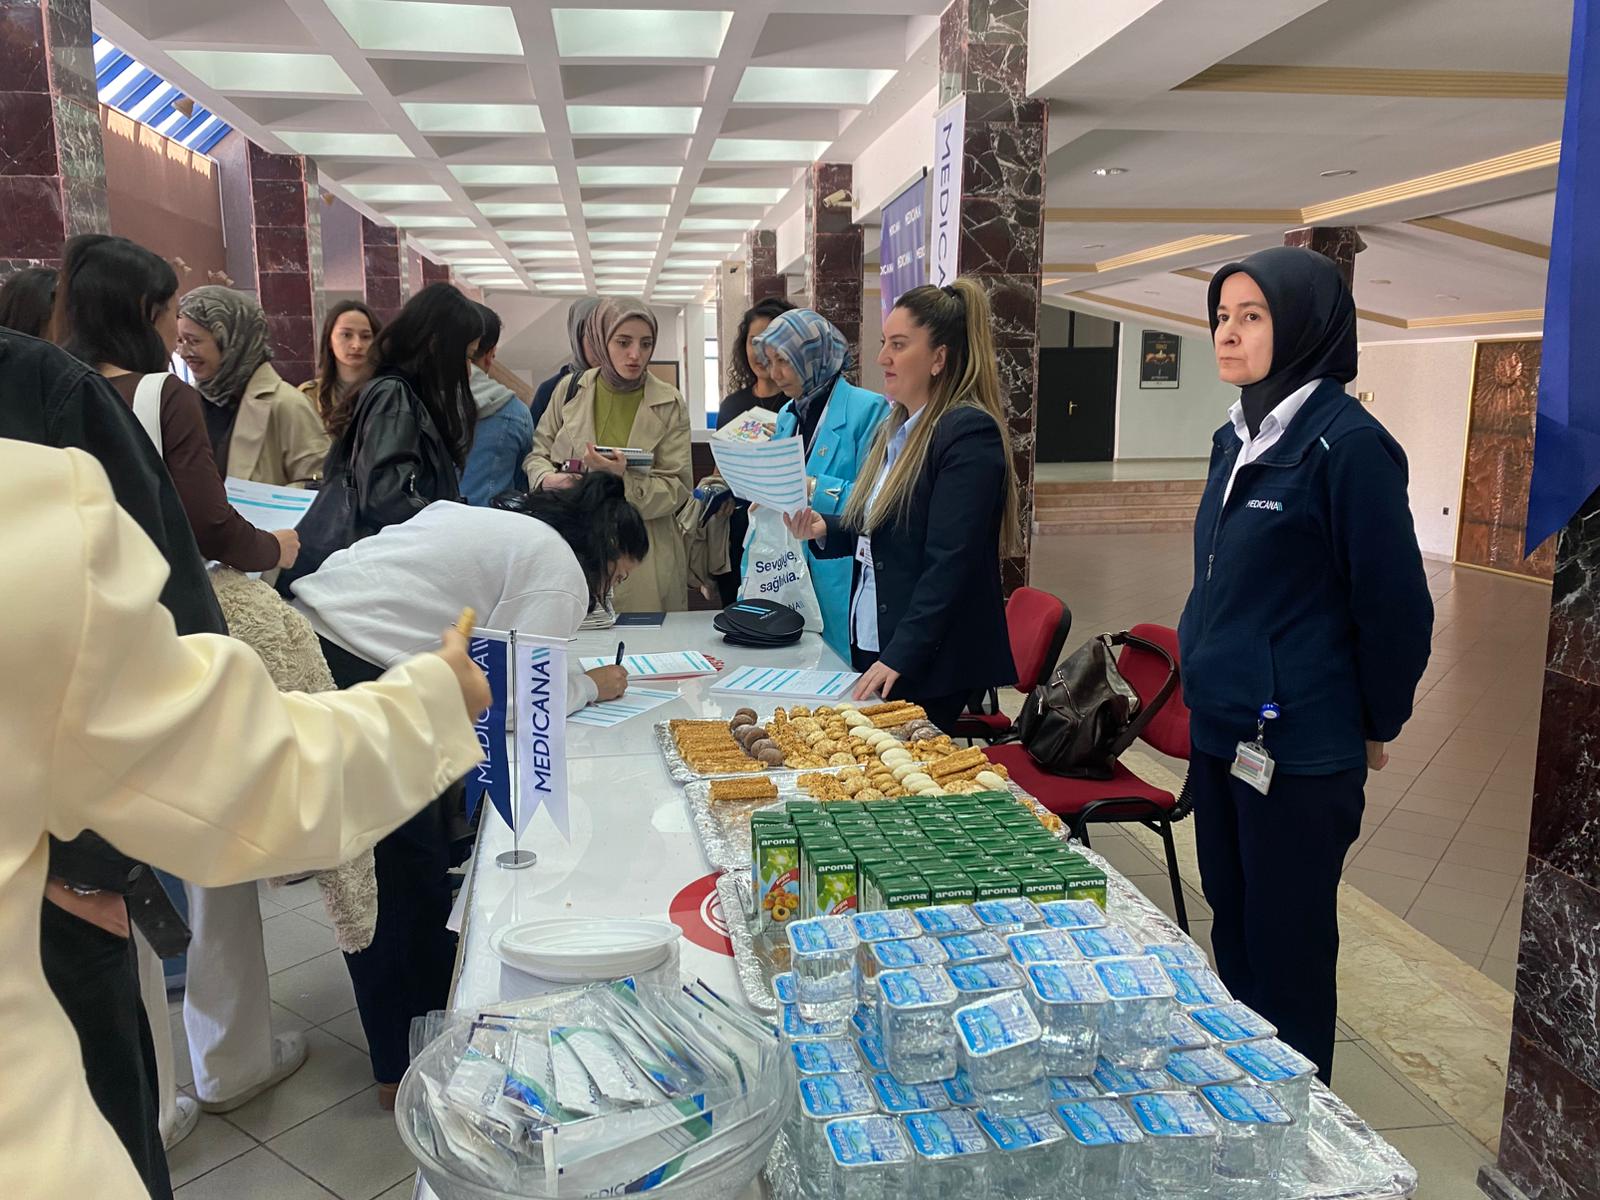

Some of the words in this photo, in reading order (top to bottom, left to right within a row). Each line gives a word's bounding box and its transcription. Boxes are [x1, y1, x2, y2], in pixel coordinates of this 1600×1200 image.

[531, 660, 552, 793] MEDICANA
[761, 838, 796, 846] aroma
[818, 863, 854, 872] aroma
[1026, 883, 1064, 893] aroma
[1069, 878, 1106, 888] aroma
[935, 889, 973, 899] aroma
[981, 886, 1018, 896] aroma
[889, 893, 927, 903] aroma
